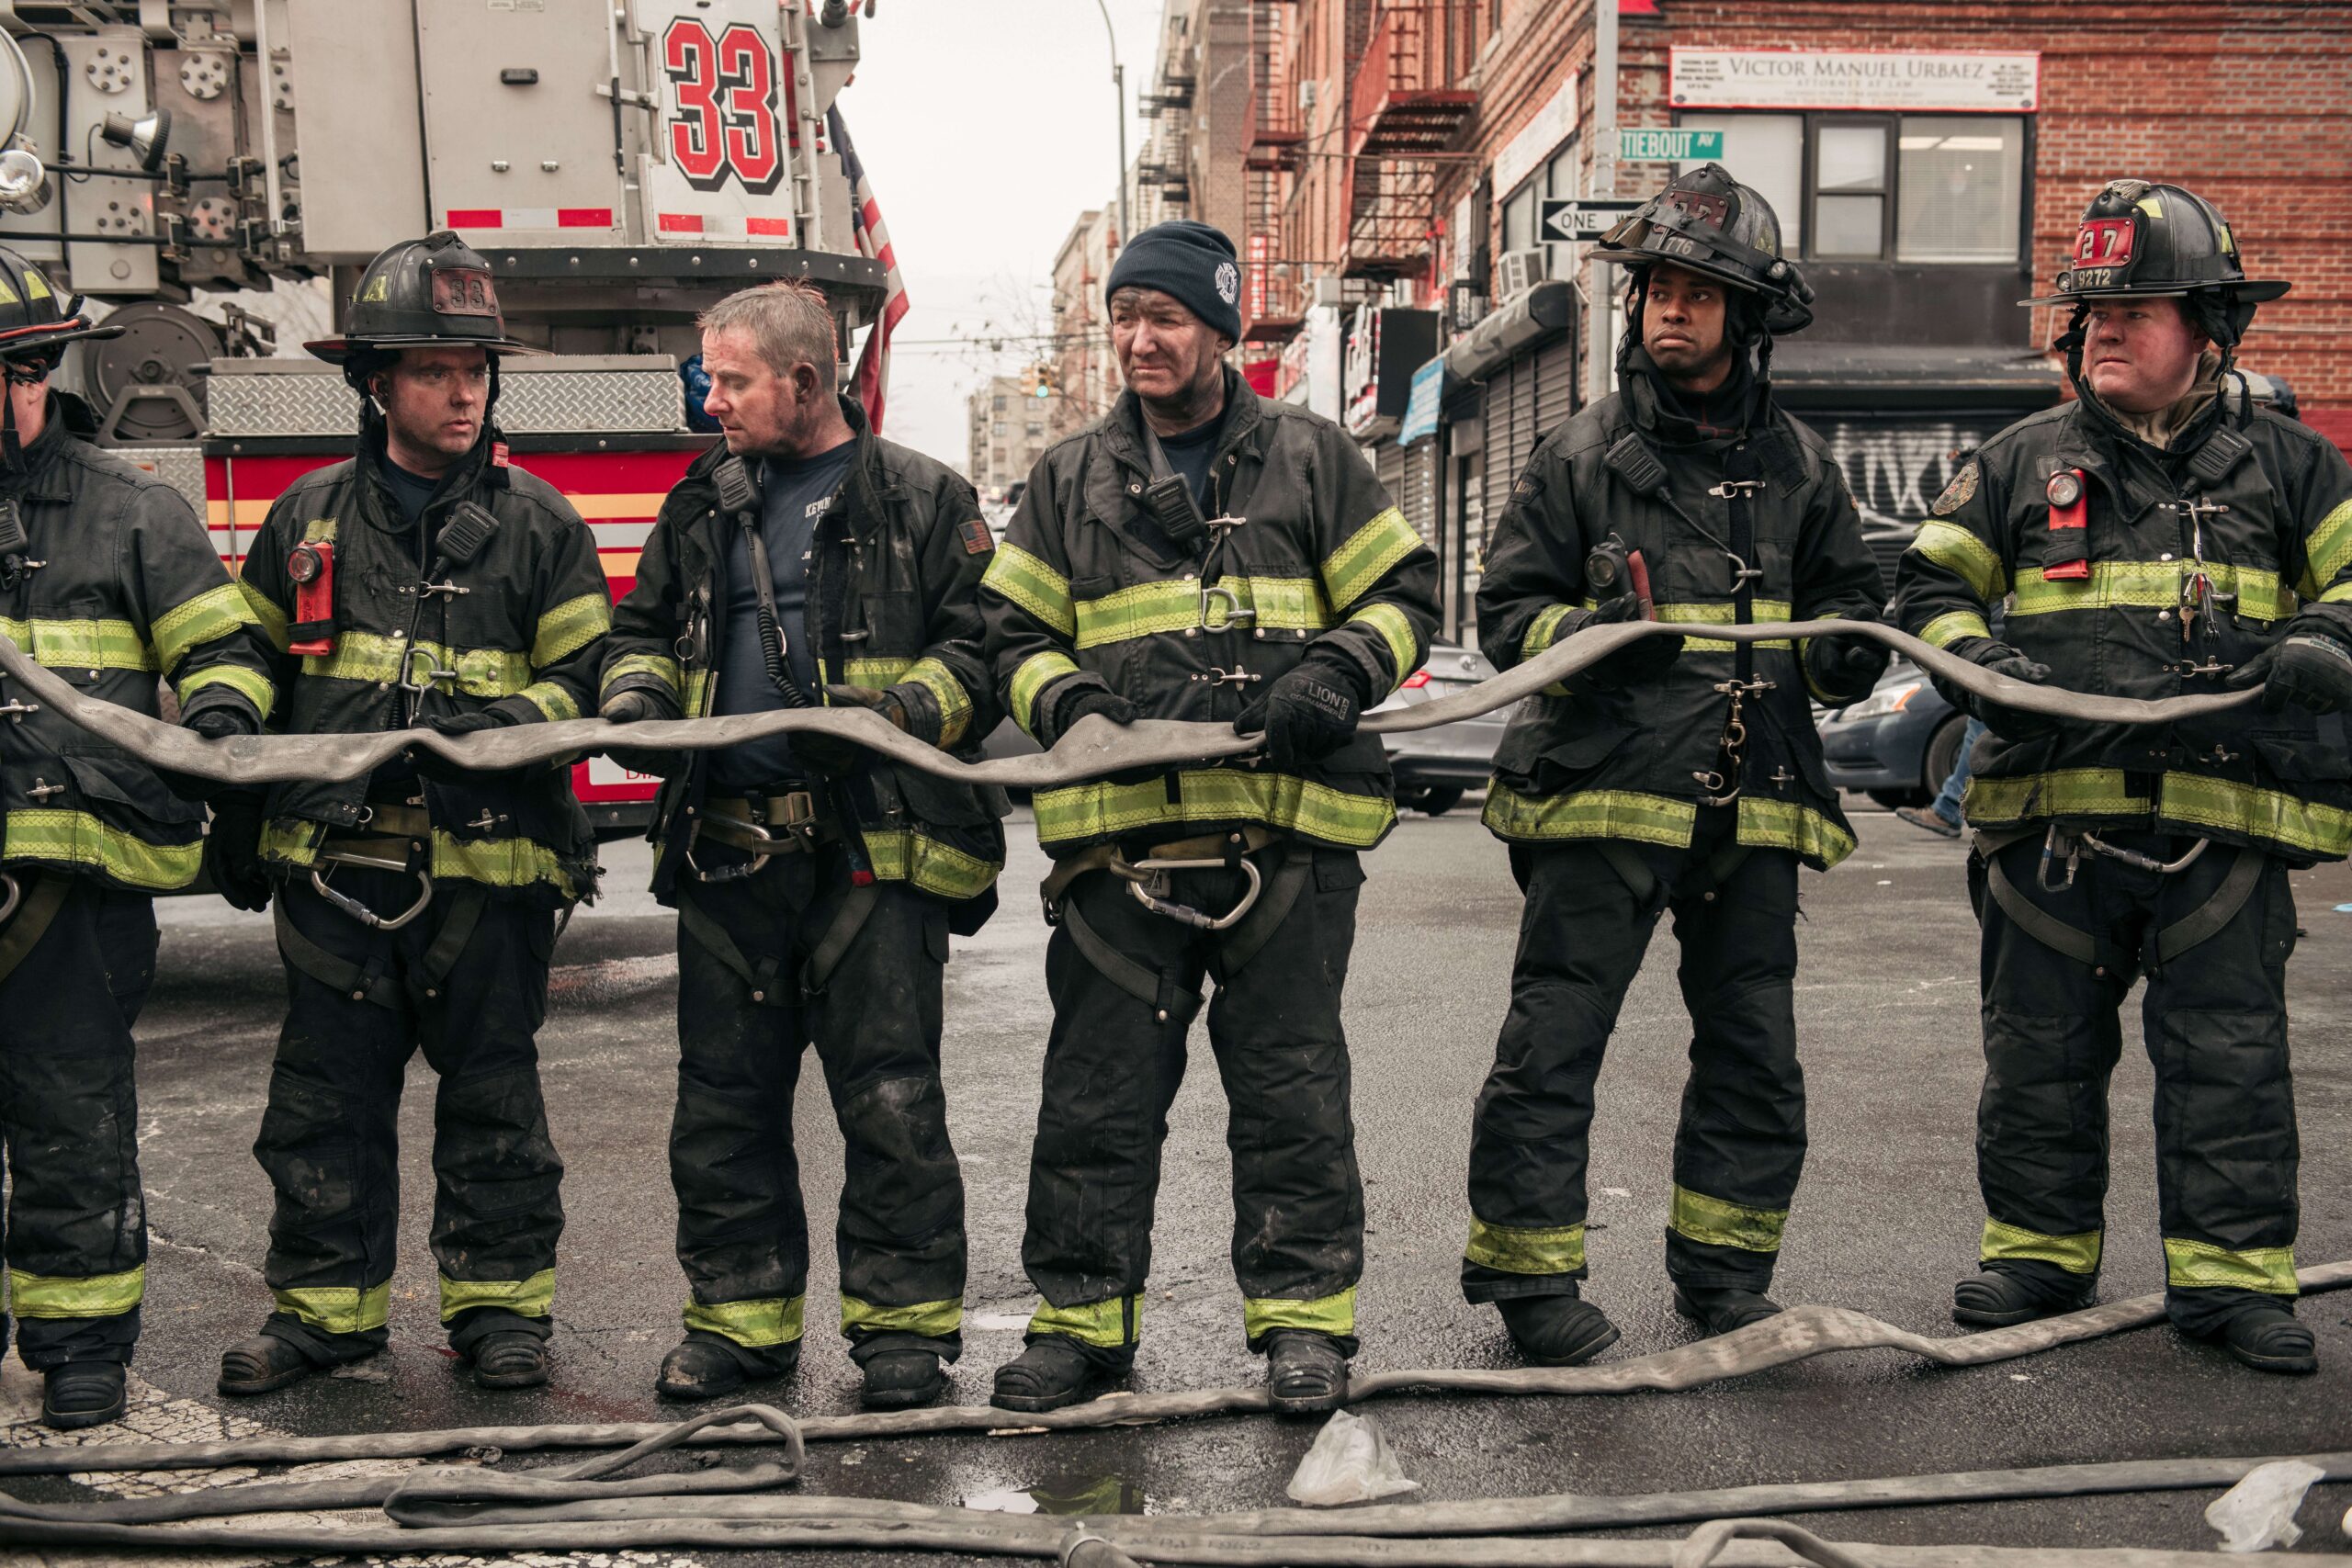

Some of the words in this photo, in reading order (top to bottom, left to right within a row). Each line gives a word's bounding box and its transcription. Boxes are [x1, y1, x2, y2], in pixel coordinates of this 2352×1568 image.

[1729, 58, 1805, 77] VICTOR
[1815, 59, 1900, 78] MANUEL
[1907, 60, 1984, 80] URBAEZ
[662, 15, 785, 196] 33
[1623, 131, 1692, 158] TIEBOUT
[1696, 131, 1716, 147] AV
[1562, 212, 1597, 230] ONE
[2080, 228, 2118, 260] 27
[2078, 267, 2112, 288] 9272
[449, 278, 486, 310] 33
[1289, 693, 1340, 717] COMMANDER
[1308, 682, 1340, 707] LION
